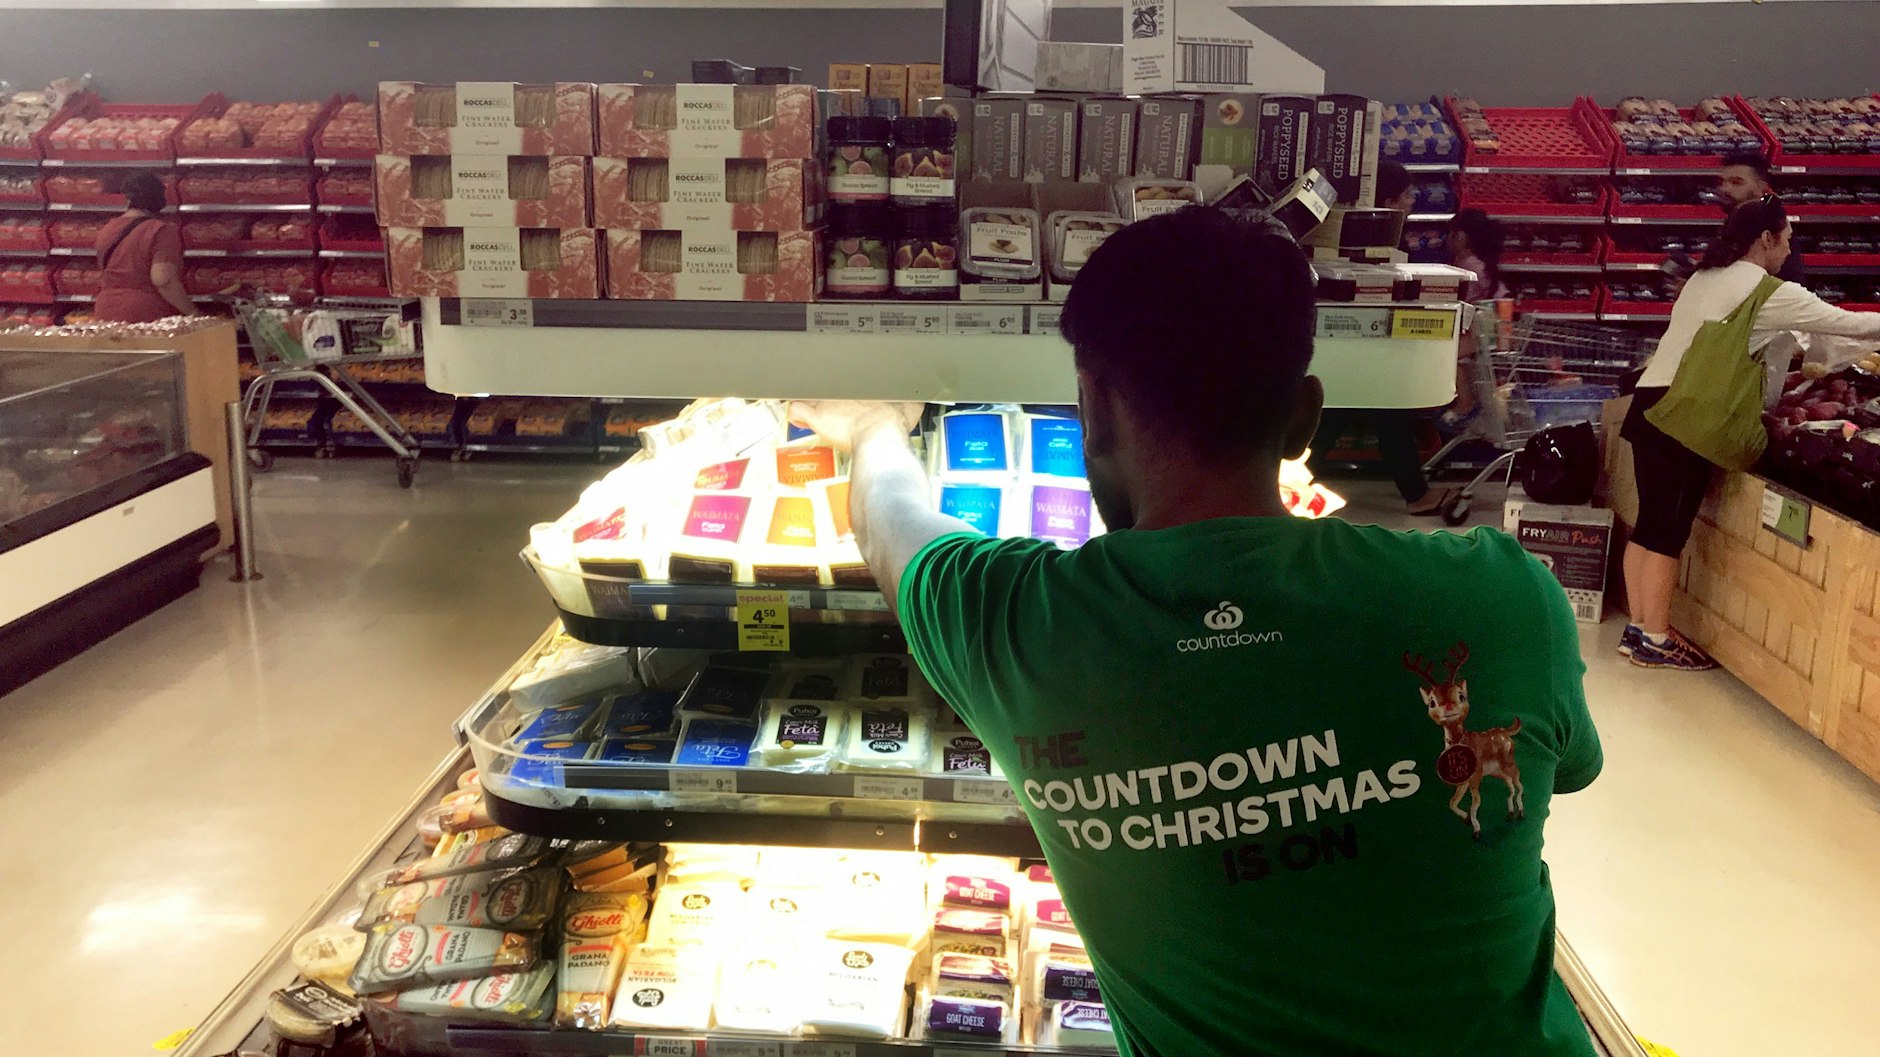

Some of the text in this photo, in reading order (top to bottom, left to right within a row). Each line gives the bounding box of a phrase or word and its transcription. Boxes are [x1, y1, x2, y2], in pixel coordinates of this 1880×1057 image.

[1102, 115, 1116, 173] NATURAL
[1158, 115, 1173, 173] NATURAL
[1278, 109, 1294, 180] POPPYSEED
[1333, 107, 1348, 178] POPPYSEED
[1141, 205, 1162, 213] Fruit
[976, 226, 1028, 236] Fruit Paste
[1071, 233, 1094, 241] Fruit
[739, 595, 785, 604] special
[1176, 629, 1283, 653] countdown
[692, 744, 741, 760] Feta
[872, 744, 898, 752] Puhoi
[1014, 731, 1088, 770] THE
[1023, 729, 1341, 813] COUNTDOWN
[1058, 759, 1422, 851] TO CHRISTMAS
[1222, 823, 1360, 885] IS ON
[571, 913, 624, 932] Ghiolli
[445, 933, 460, 961] GRANA
[455, 930, 471, 963] PADANO
[567, 960, 611, 969] PADANO
[571, 952, 608, 961] GRANA
[1062, 975, 1084, 988] CHEESE
[946, 1012, 986, 1027] GOAT CHEESE
[654, 1046, 687, 1055] PRICE
